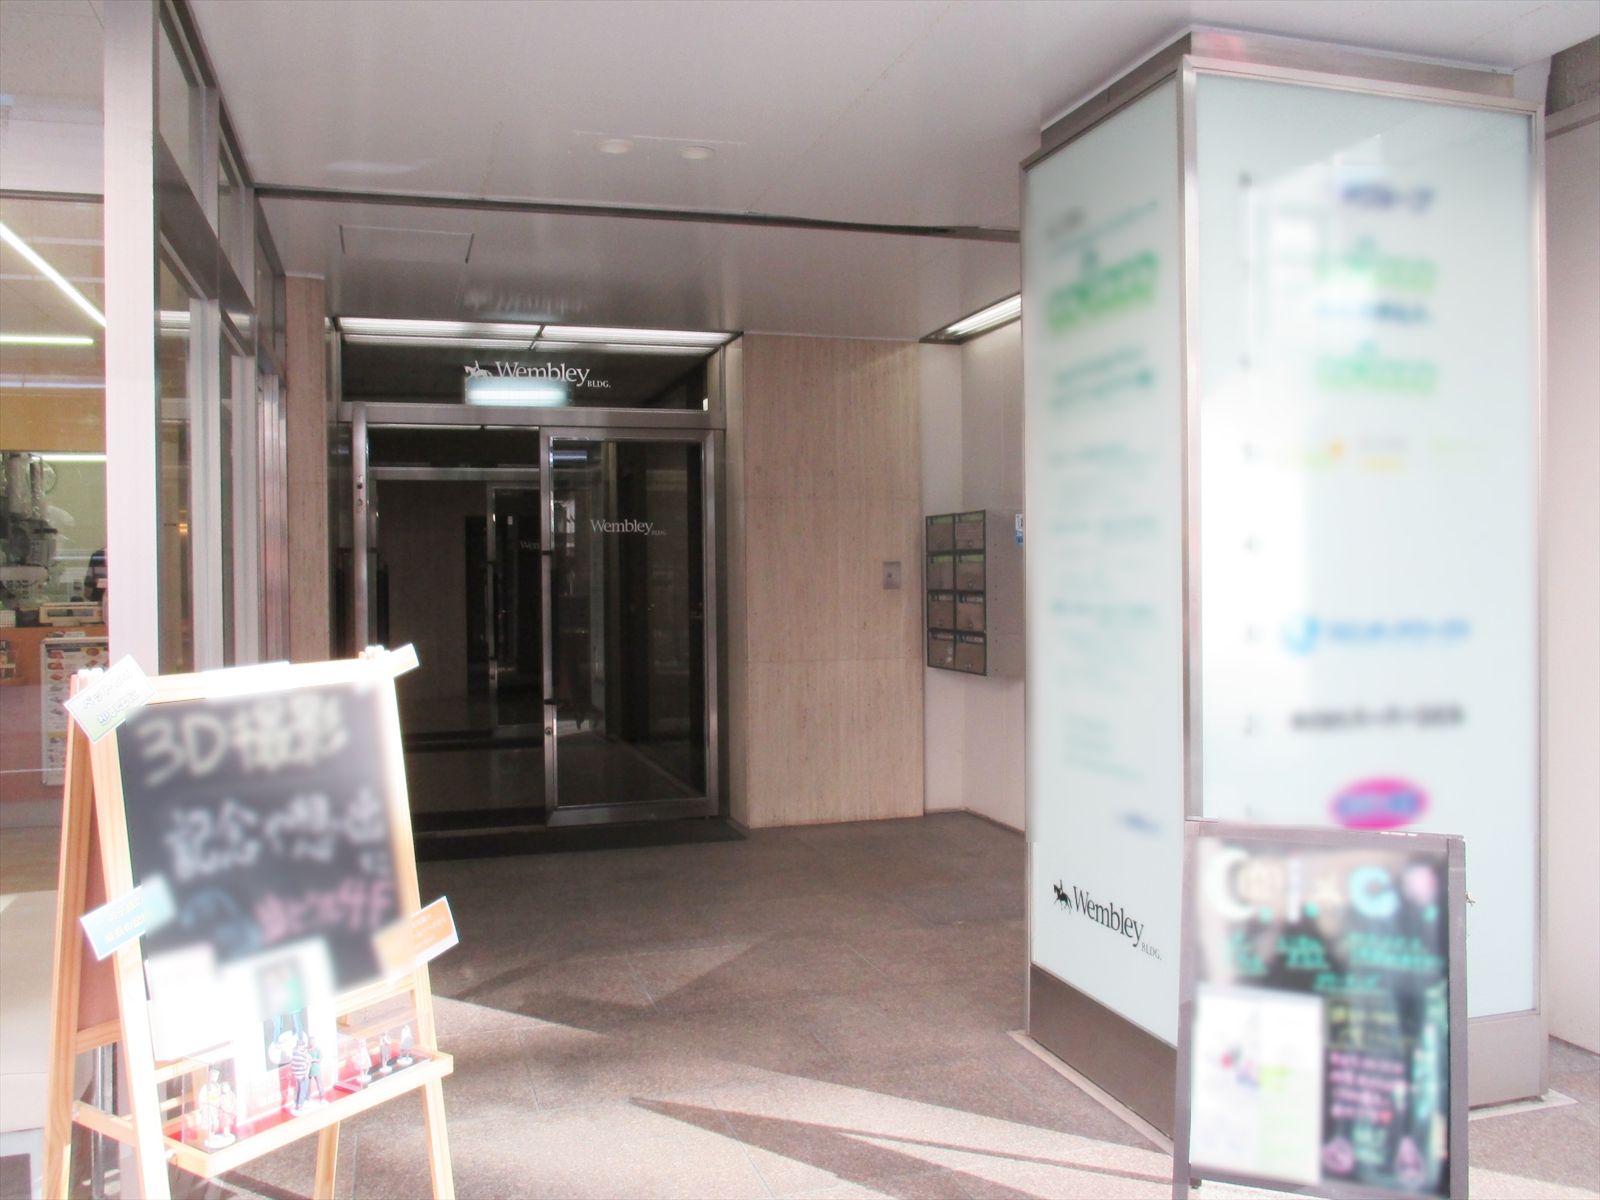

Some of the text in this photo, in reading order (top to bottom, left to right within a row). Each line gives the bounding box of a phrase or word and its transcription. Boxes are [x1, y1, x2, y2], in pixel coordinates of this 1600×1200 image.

[495, 361, 611, 388] Wembley BLDG.
[590, 519, 654, 535] Wembley
[1073, 885, 1144, 947] Wembley
